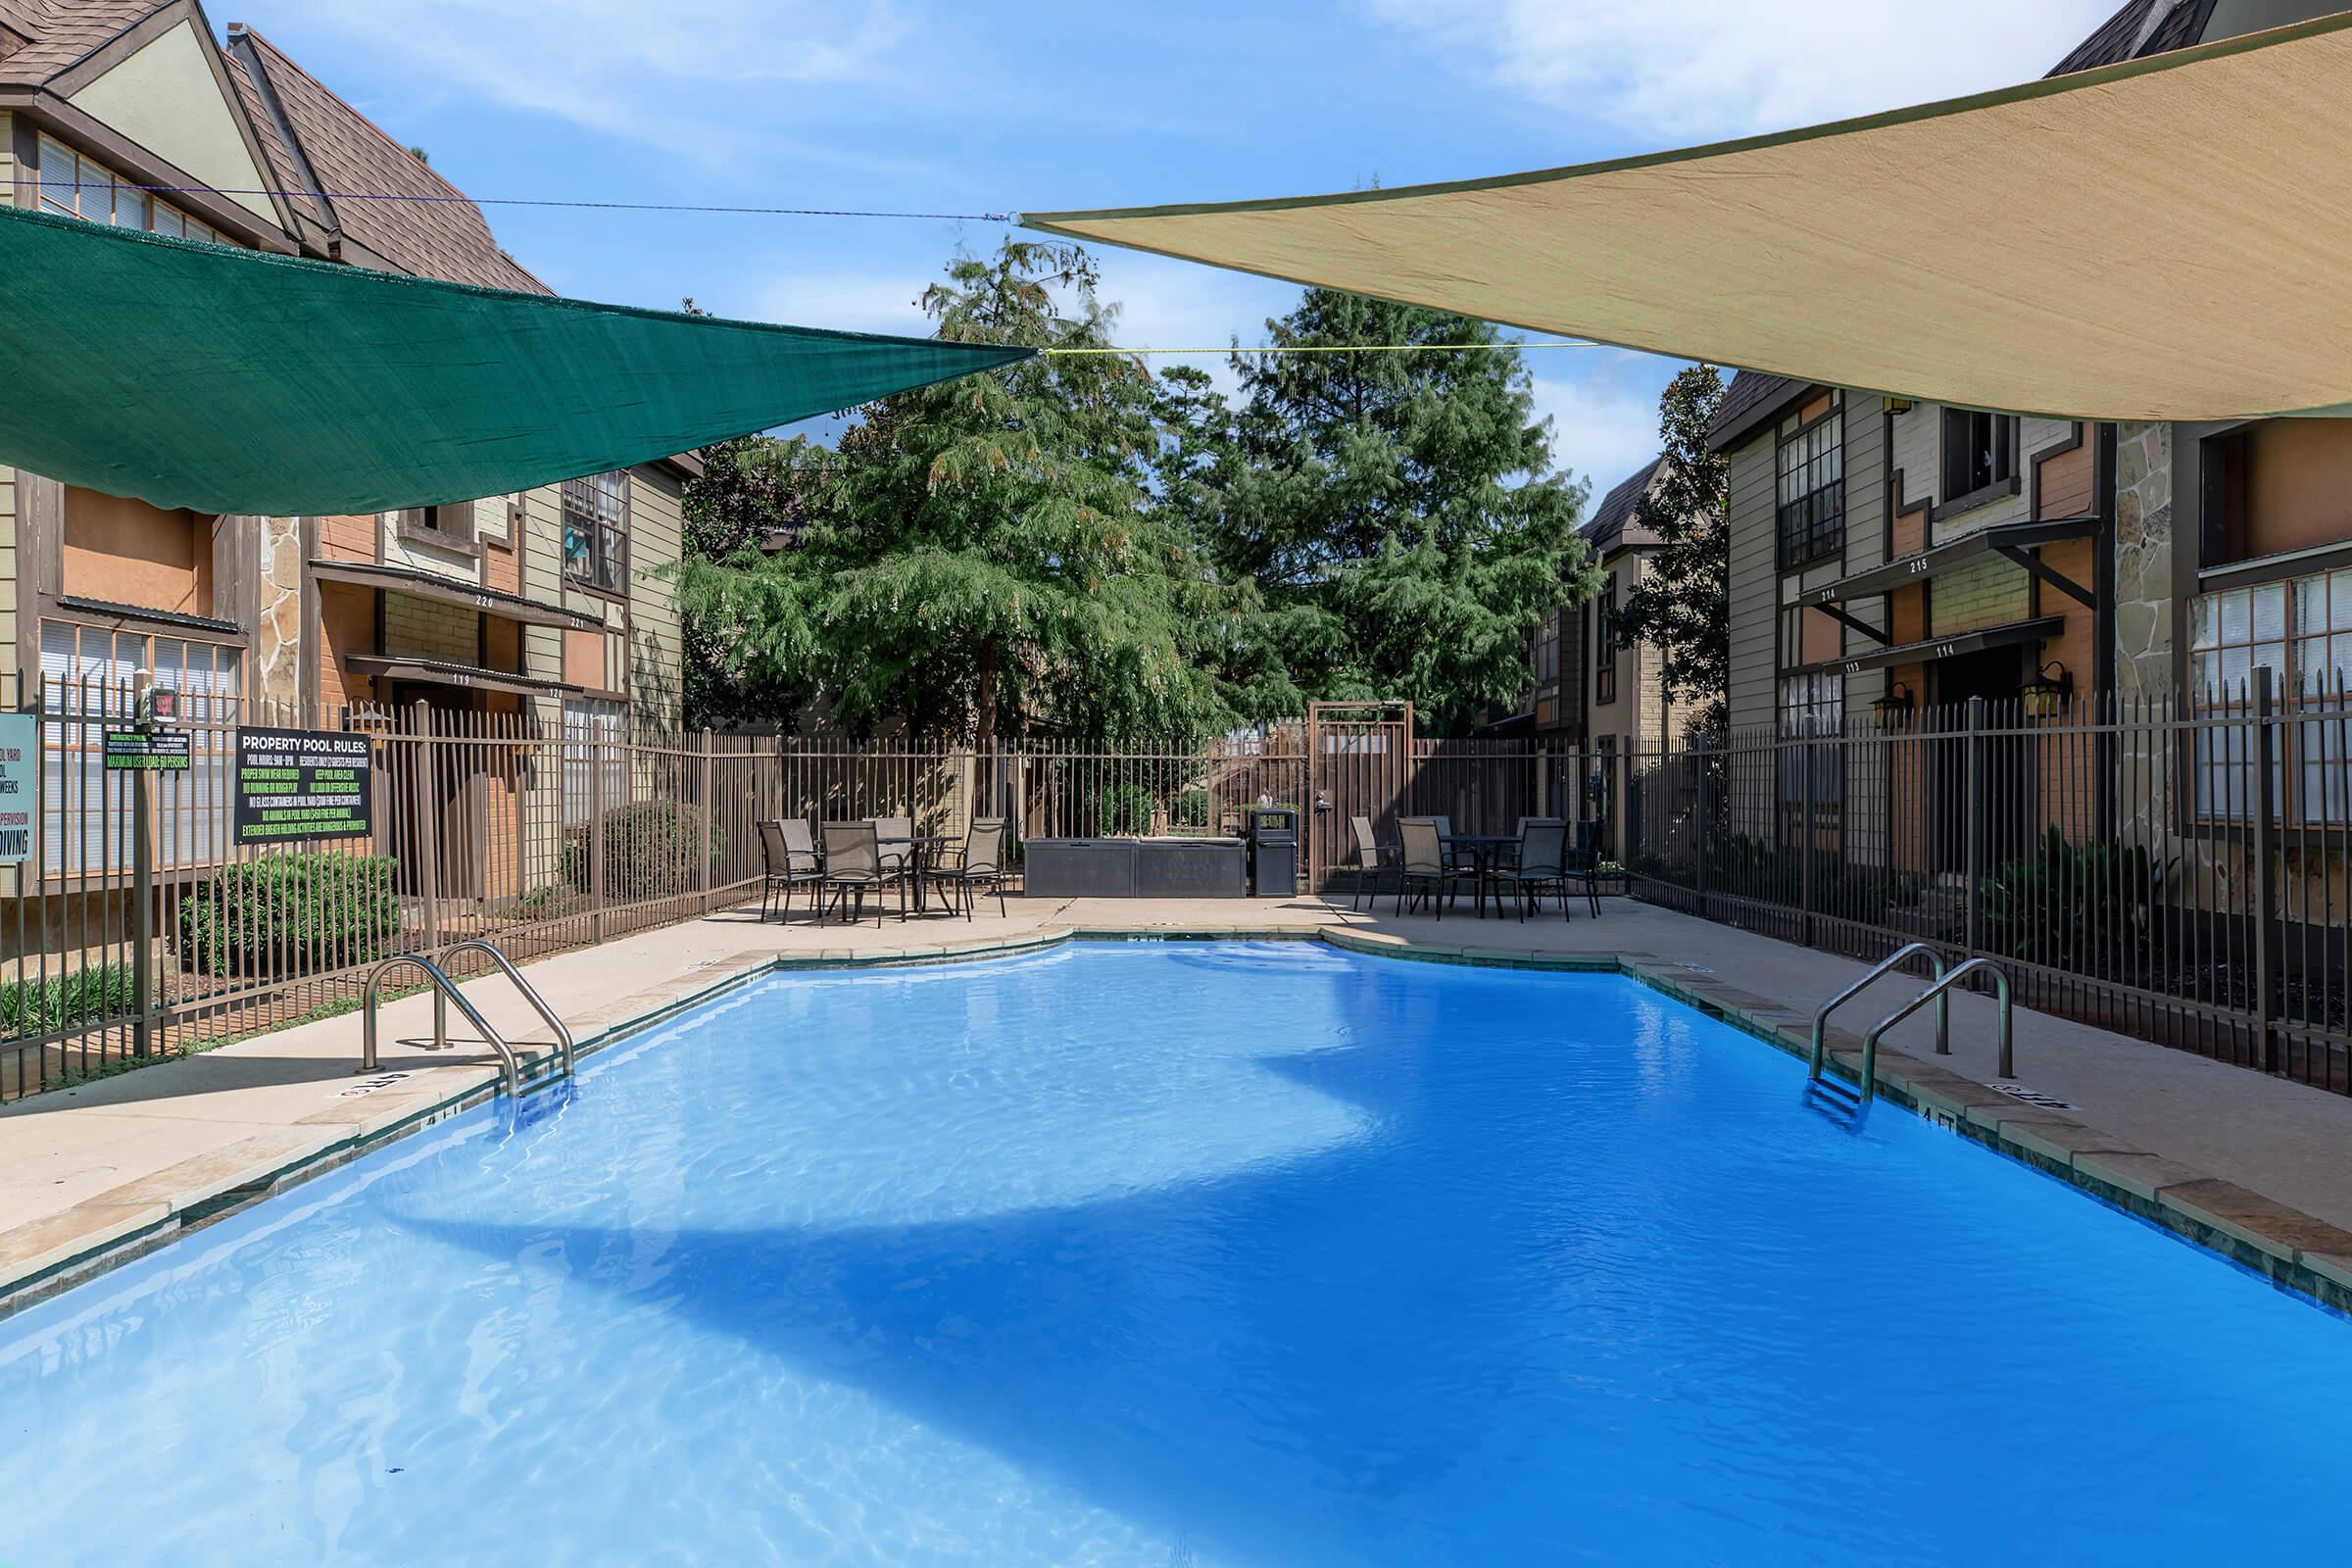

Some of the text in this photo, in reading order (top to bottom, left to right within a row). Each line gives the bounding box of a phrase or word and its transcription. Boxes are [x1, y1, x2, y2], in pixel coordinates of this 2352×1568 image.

[1910, 559, 1928, 573] 215
[475, 595, 493, 608] 220
[1821, 589, 1835, 601] 214
[571, 617, 584, 628] 221
[1936, 644, 1954, 659] 114
[1846, 662, 1860, 673] 113
[453, 674, 470, 685] 119
[550, 688, 563, 699] 120
[243, 736, 366, 753] PROPERTY POOL RULES:
[7, 748, 21, 761] YARD
[107, 754, 133, 768] MAXIMUM
[133, 755, 146, 768] USER
[146, 755, 160, 768] LOAD:
[168, 755, 188, 768] PERSONS
[247, 754, 258, 766] POOL
[1923, 1106, 1955, 1133] 4 FT
